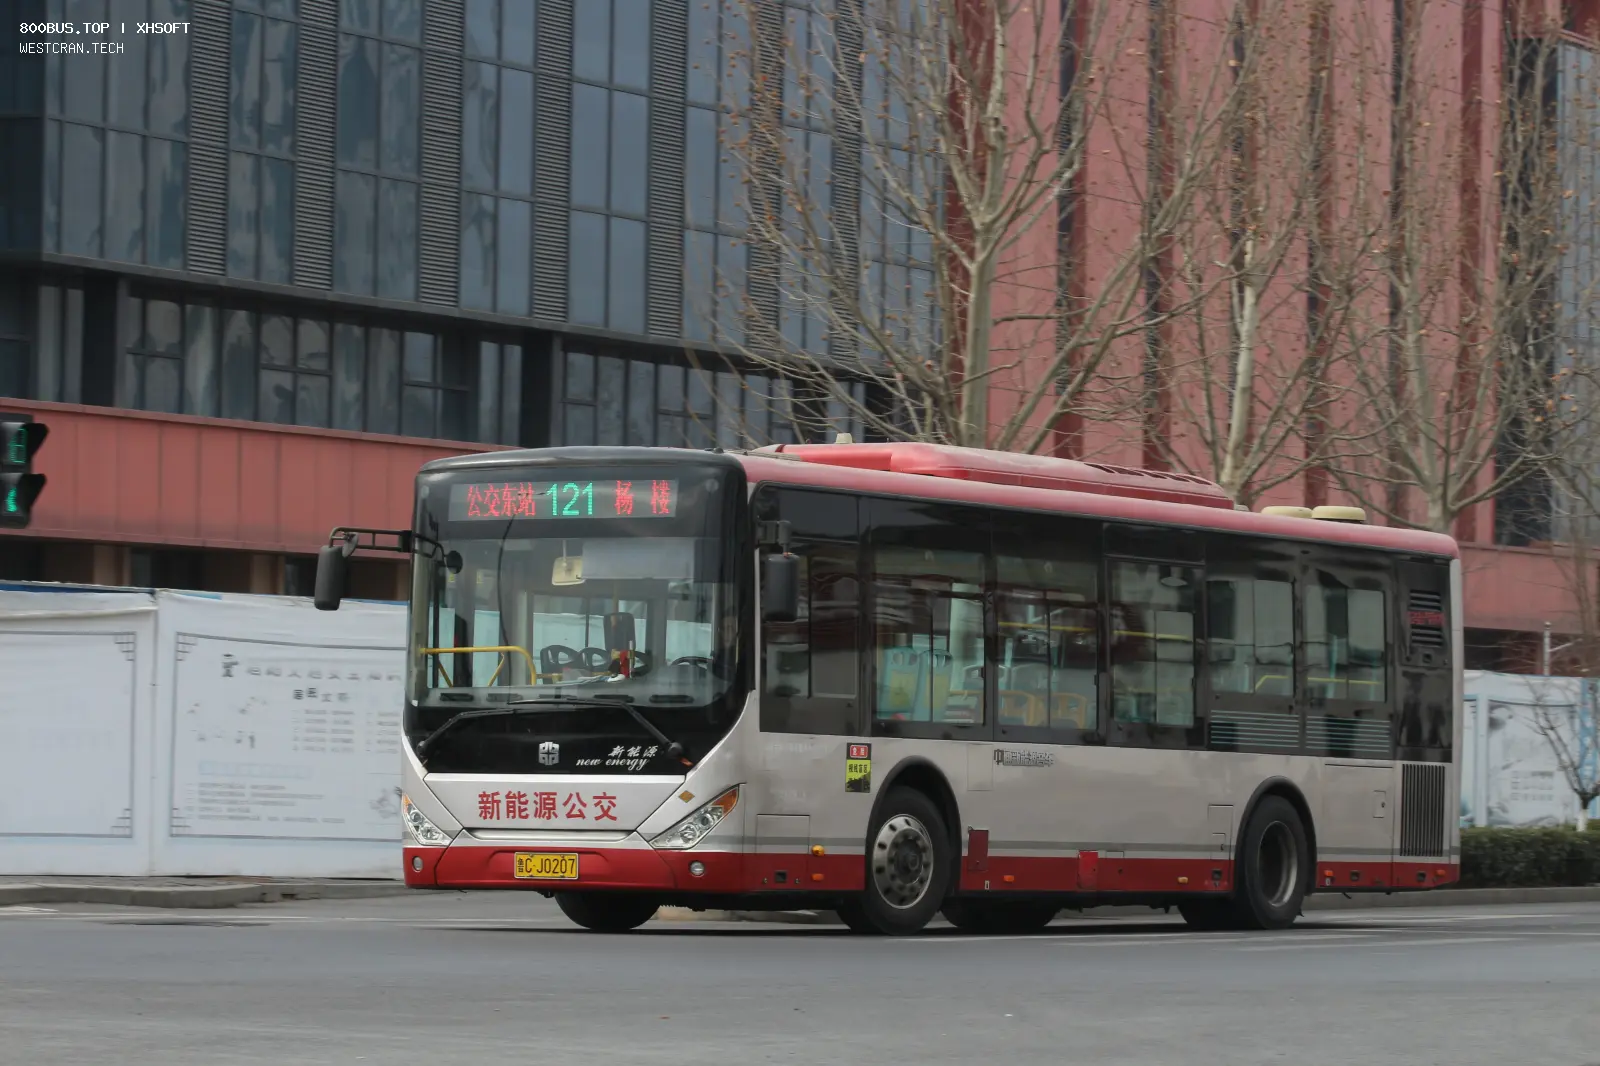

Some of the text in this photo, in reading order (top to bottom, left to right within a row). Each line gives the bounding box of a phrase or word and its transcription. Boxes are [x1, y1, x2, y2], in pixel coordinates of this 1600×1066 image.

[467, 481, 536, 517] 公交东站
[546, 482, 593, 516] 121
[608, 744, 659, 758] 新能源
[575, 757, 650, 771] new energy
[478, 790, 618, 821] 新能源公交
